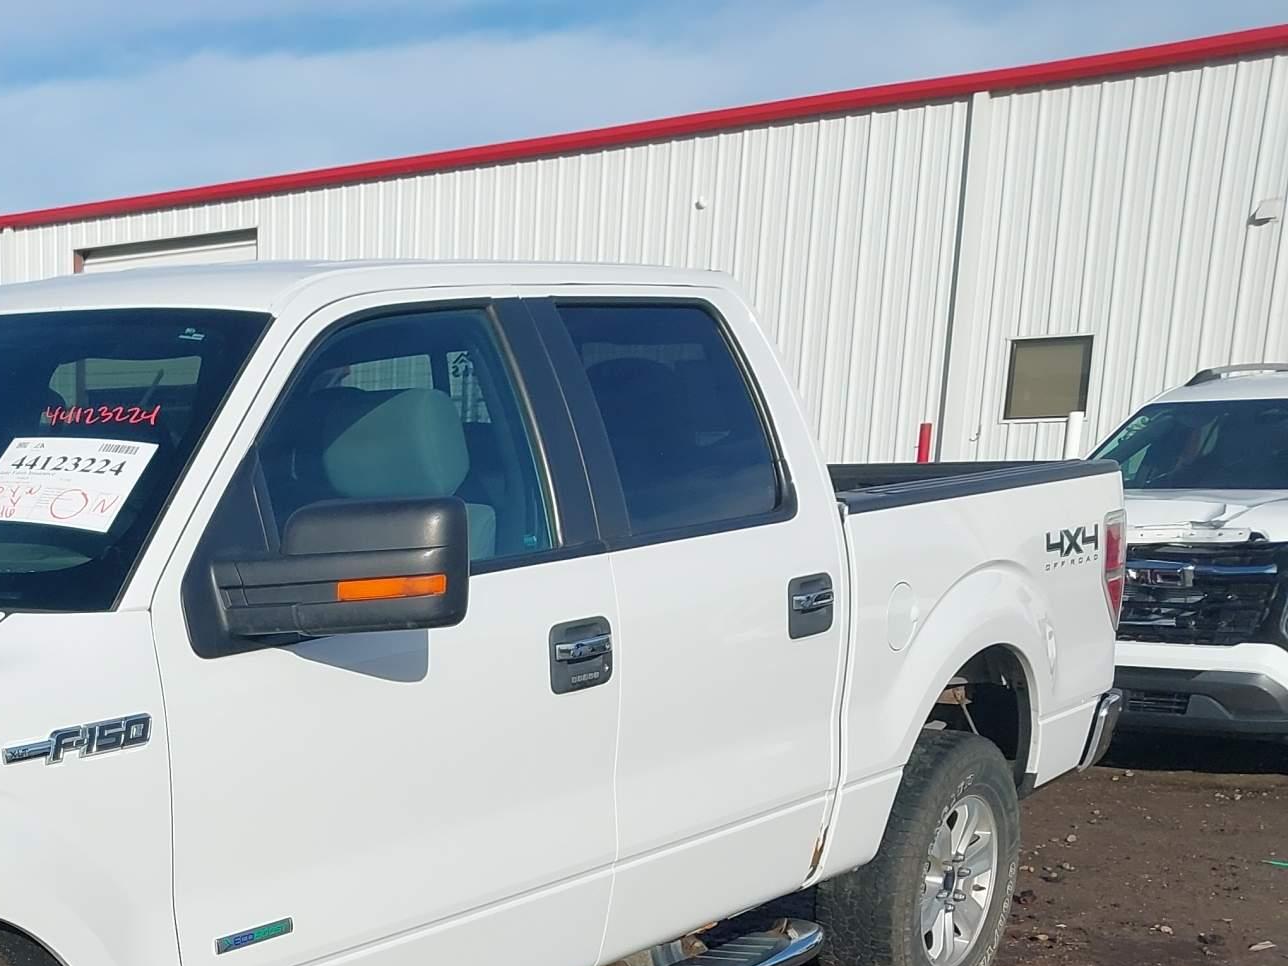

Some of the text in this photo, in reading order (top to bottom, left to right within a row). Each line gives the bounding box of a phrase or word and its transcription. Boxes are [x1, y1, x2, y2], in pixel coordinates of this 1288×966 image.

[46, 404, 161, 426] 44123224
[11, 455, 127, 476] 44123224
[1045, 523, 1099, 557] 4X4
